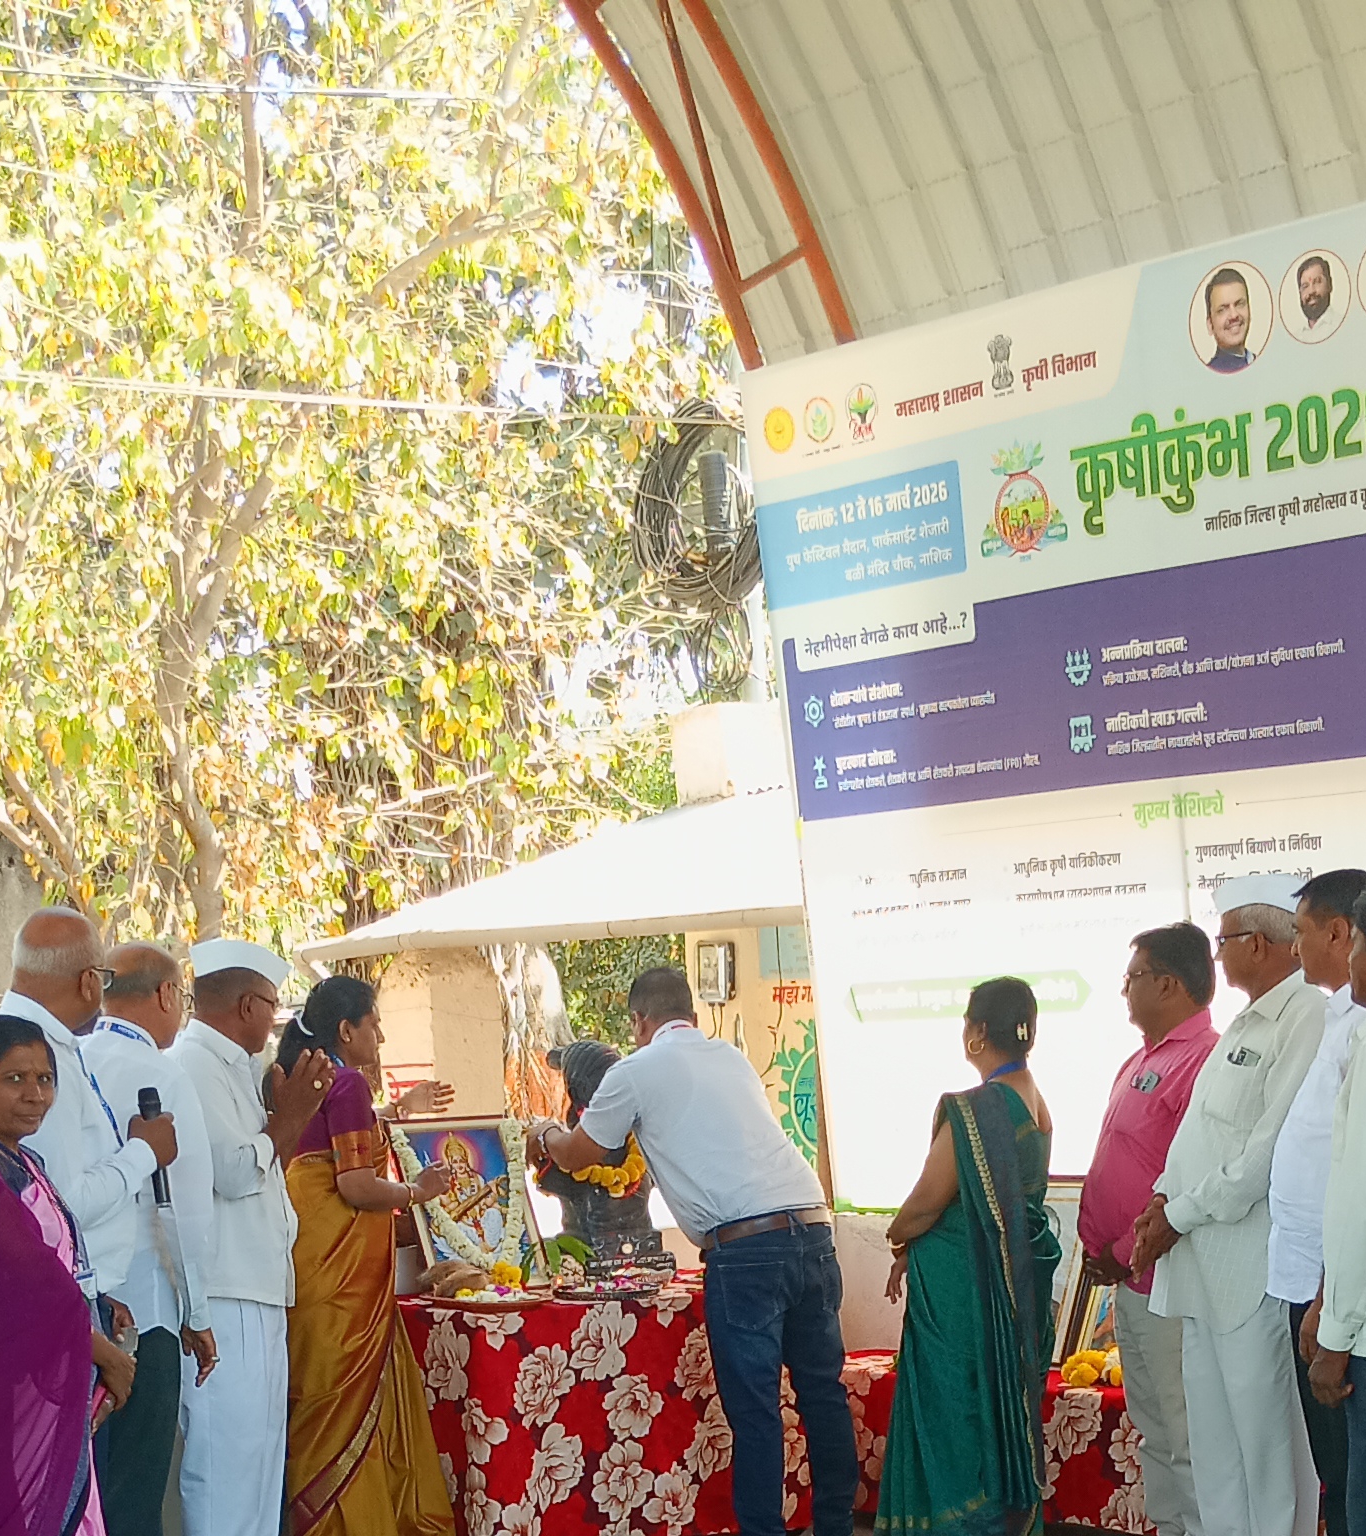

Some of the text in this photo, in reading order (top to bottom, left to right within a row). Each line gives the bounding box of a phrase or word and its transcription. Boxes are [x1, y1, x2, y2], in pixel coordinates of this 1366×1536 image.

[1021, 351, 1097, 391] कृषी विभाग
[894, 380, 984, 417] महाराष्ट्र शासन
[1070, 407, 1252, 536] कृषीकुंभ
[840, 503, 854, 524] 12
[856, 494, 866, 520] ते
[868, 496, 883, 517] 16
[884, 483, 911, 512] मार्च
[913, 480, 948, 507] 2026
[1204, 509, 1241, 532] नाशिक
[1244, 504, 1276, 526] जिल्हा
[1278, 497, 1300, 525] कृषी
[1302, 492, 1347, 513] महोत्सव
[1349, 489, 1358, 505] व
[919, 547, 952, 566] नाशिक
[804, 633, 856, 658] नेहमीपेक्षा
[860, 624, 888, 646] वेगळे
[892, 623, 918, 640] काय
[1133, 800, 1170, 828] मुख्य
